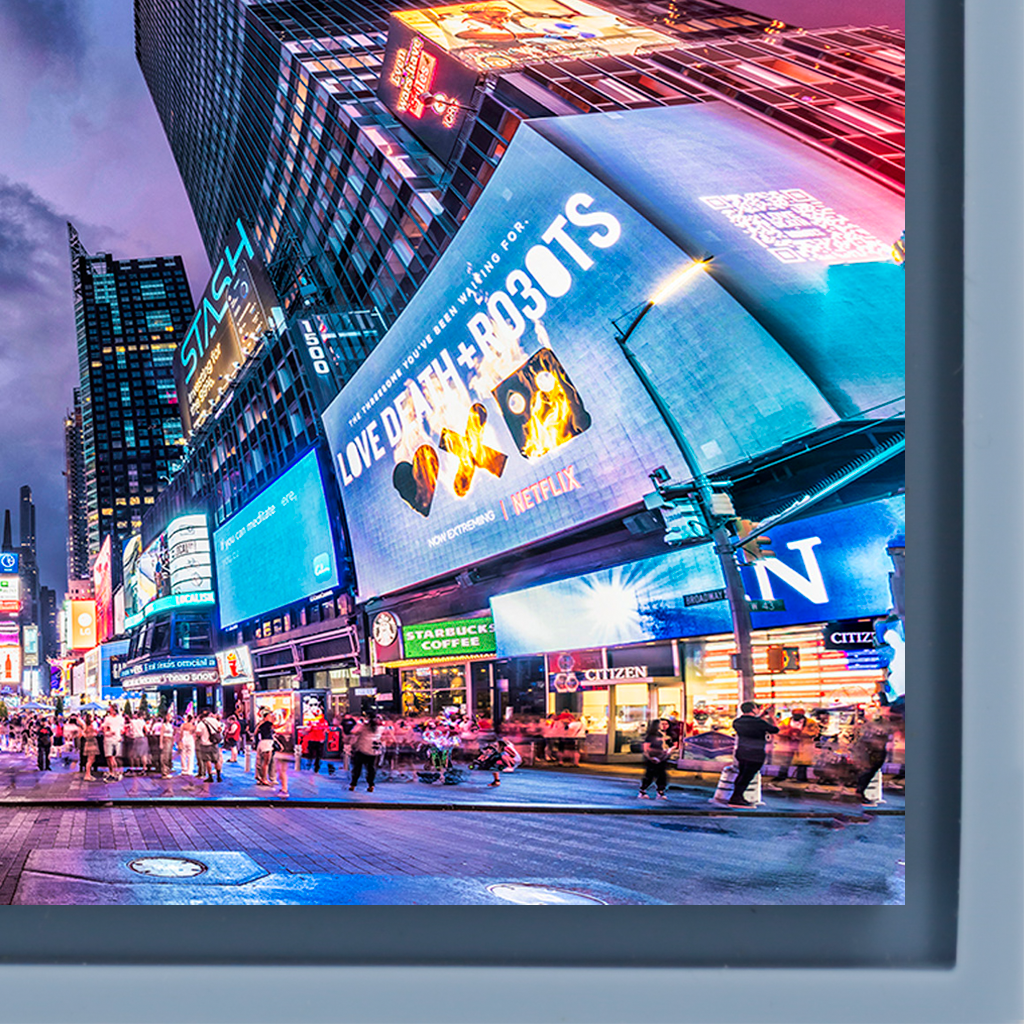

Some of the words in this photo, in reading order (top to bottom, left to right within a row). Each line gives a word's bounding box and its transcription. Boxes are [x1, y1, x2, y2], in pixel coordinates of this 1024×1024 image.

[434, 308, 459, 336] BEEN
[500, 219, 530, 251] FOR.
[180, 217, 255, 385] STASH
[301, 320, 331, 374] 1500
[336, 438, 386, 486] LOVE
[381, 348, 459, 449] DEATH
[510, 464, 582, 516] NETFLIX
[684, 590, 725, 606] BROADWAY
[79, 628, 92, 636] LG
[406, 623, 495, 642] STARBUCKS
[830, 631, 876, 644] CITIZ
[421, 636, 480, 651] COFFEE
[584, 665, 648, 681] CITIZEN
